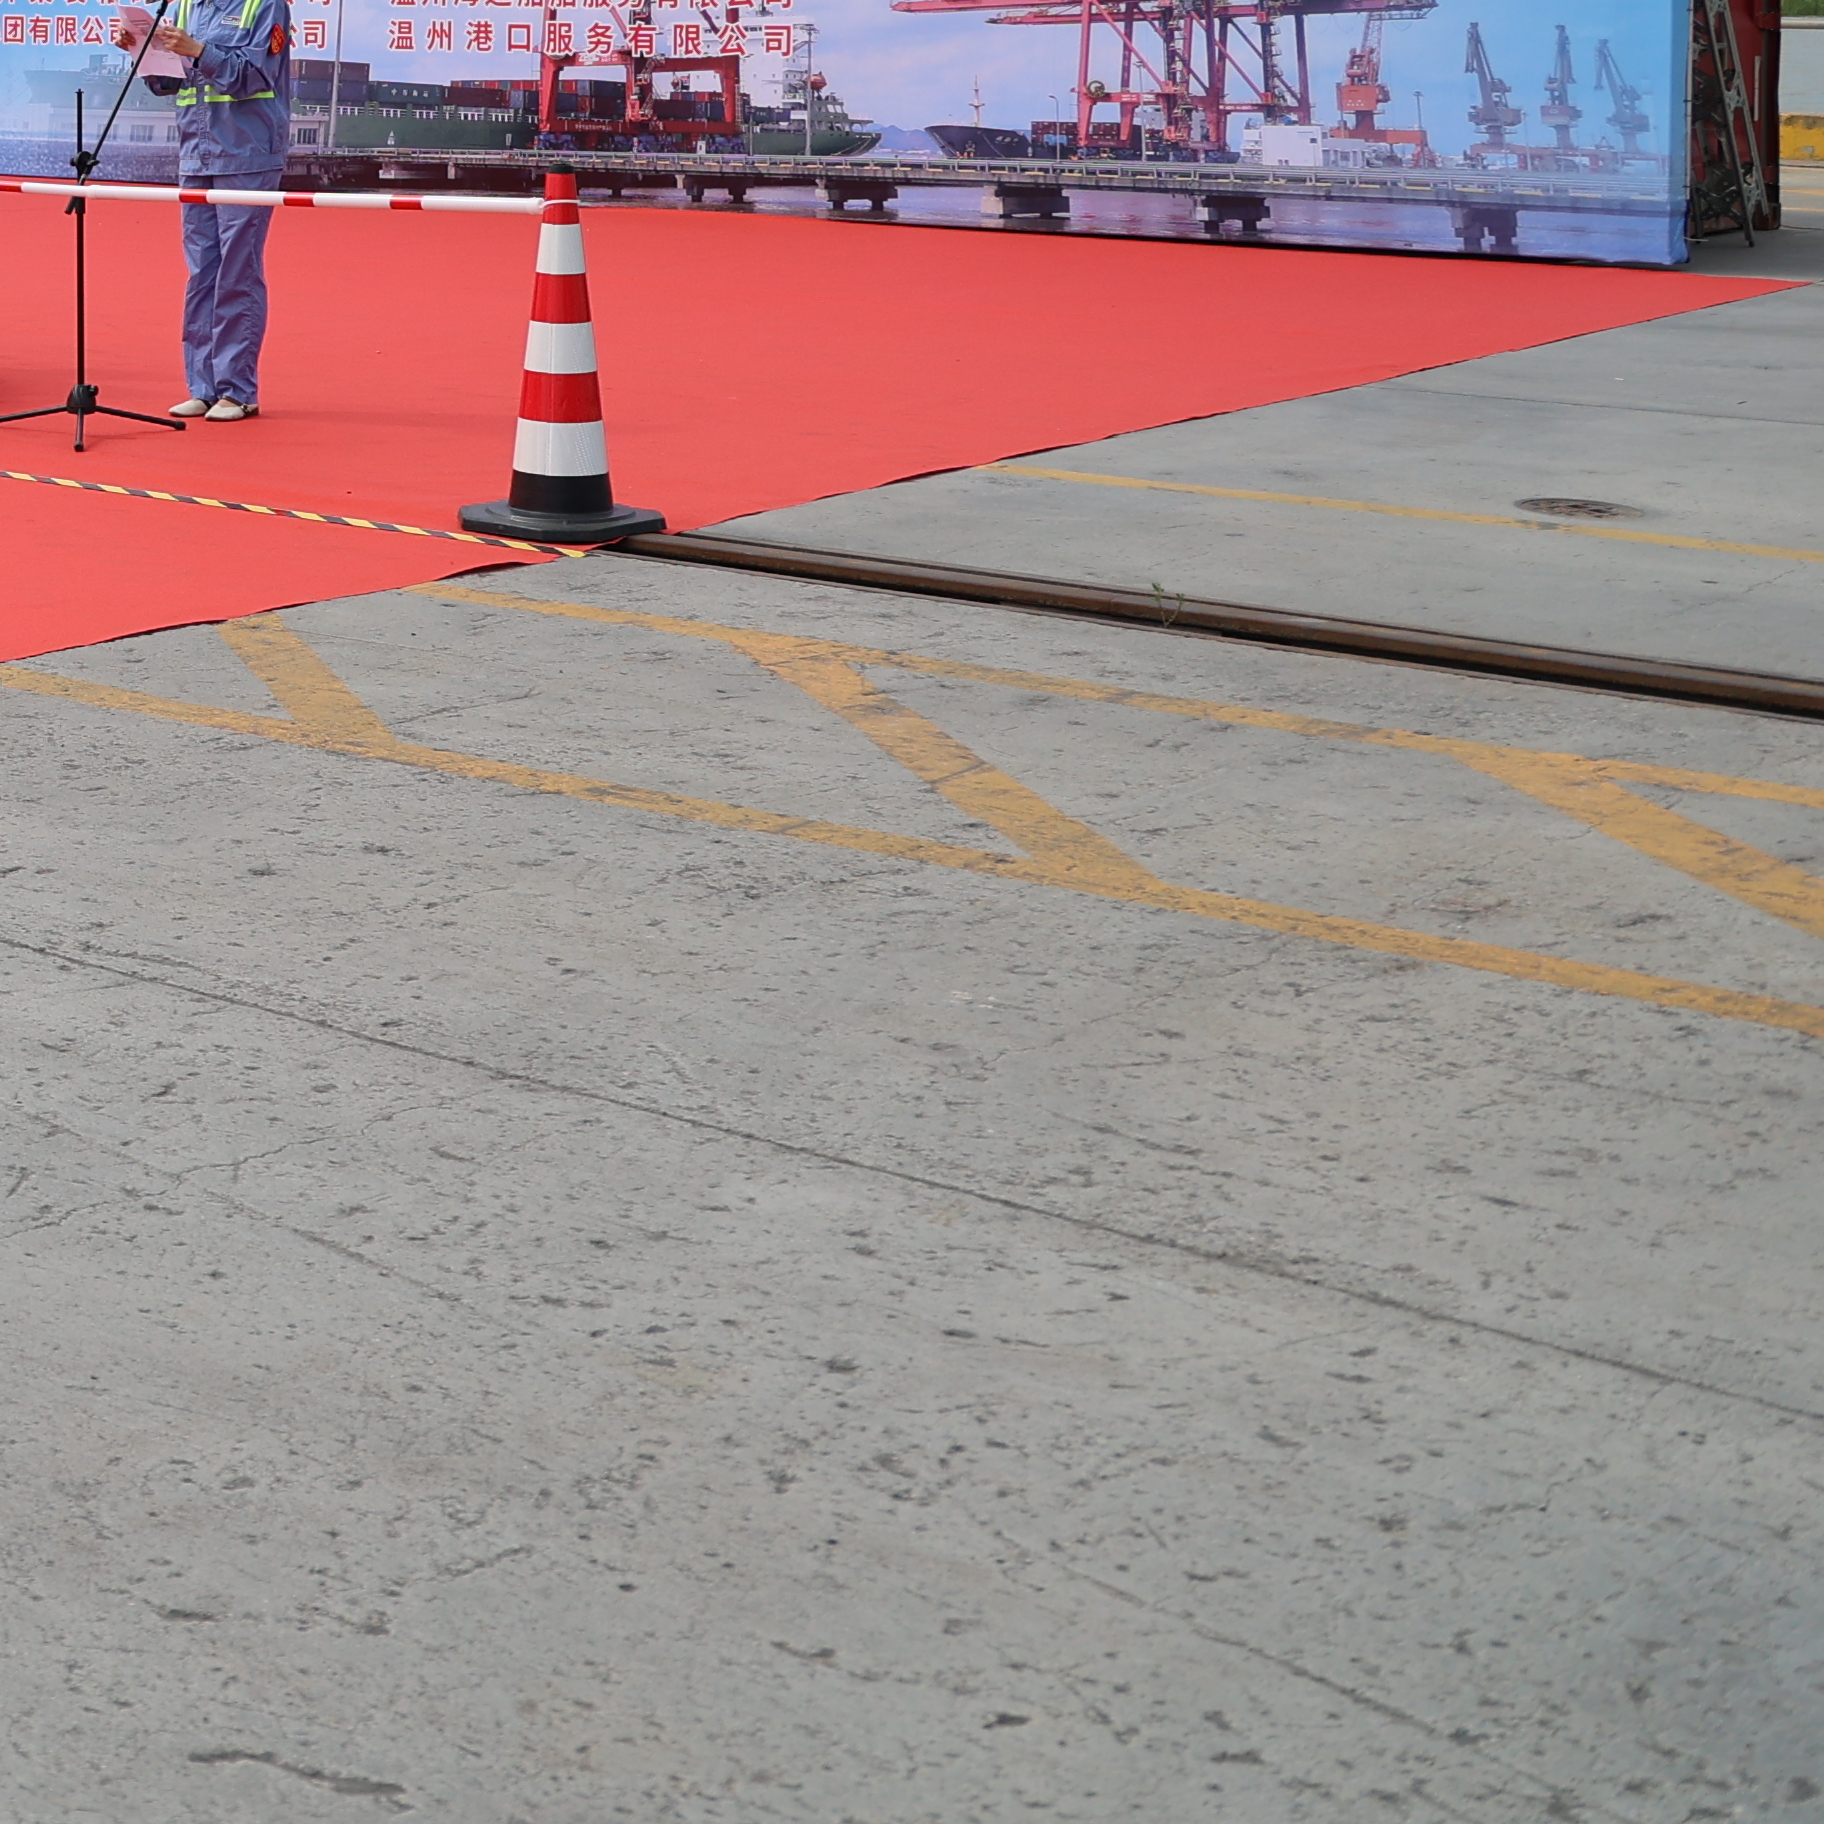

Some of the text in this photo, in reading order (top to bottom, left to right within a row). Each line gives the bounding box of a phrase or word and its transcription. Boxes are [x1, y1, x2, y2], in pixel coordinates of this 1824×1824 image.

[388, 19, 793, 57] 温州港口服务有限公司
